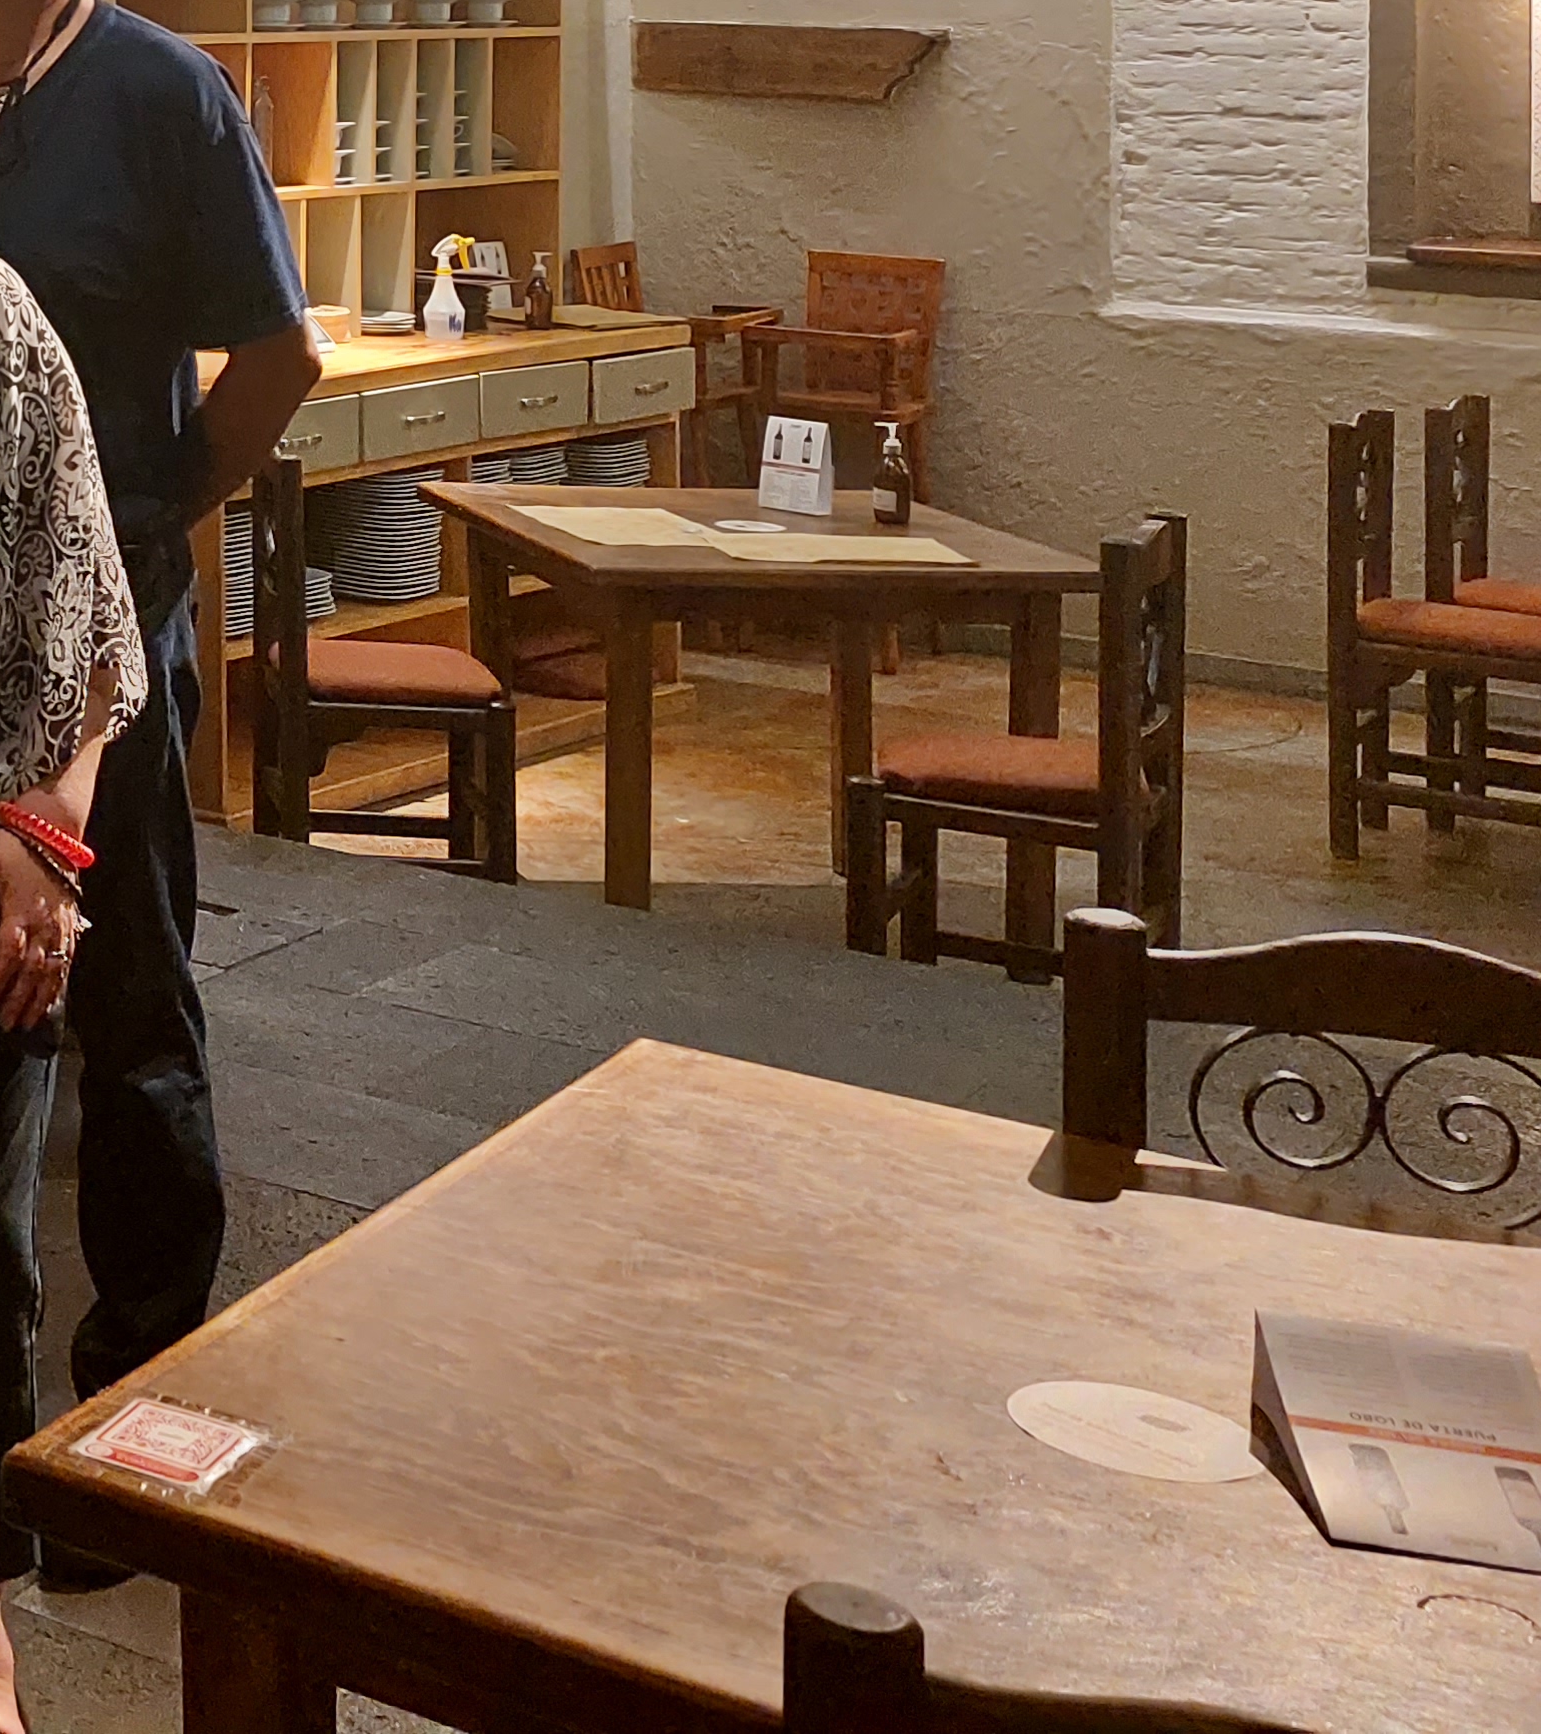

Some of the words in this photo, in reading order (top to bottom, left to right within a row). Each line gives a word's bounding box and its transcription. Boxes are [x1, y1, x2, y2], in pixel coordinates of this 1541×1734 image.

[1348, 1411, 1396, 1427] LOBO
[1403, 1418, 1424, 1431] DE
[1428, 1424, 1498, 1442] PUERTA
